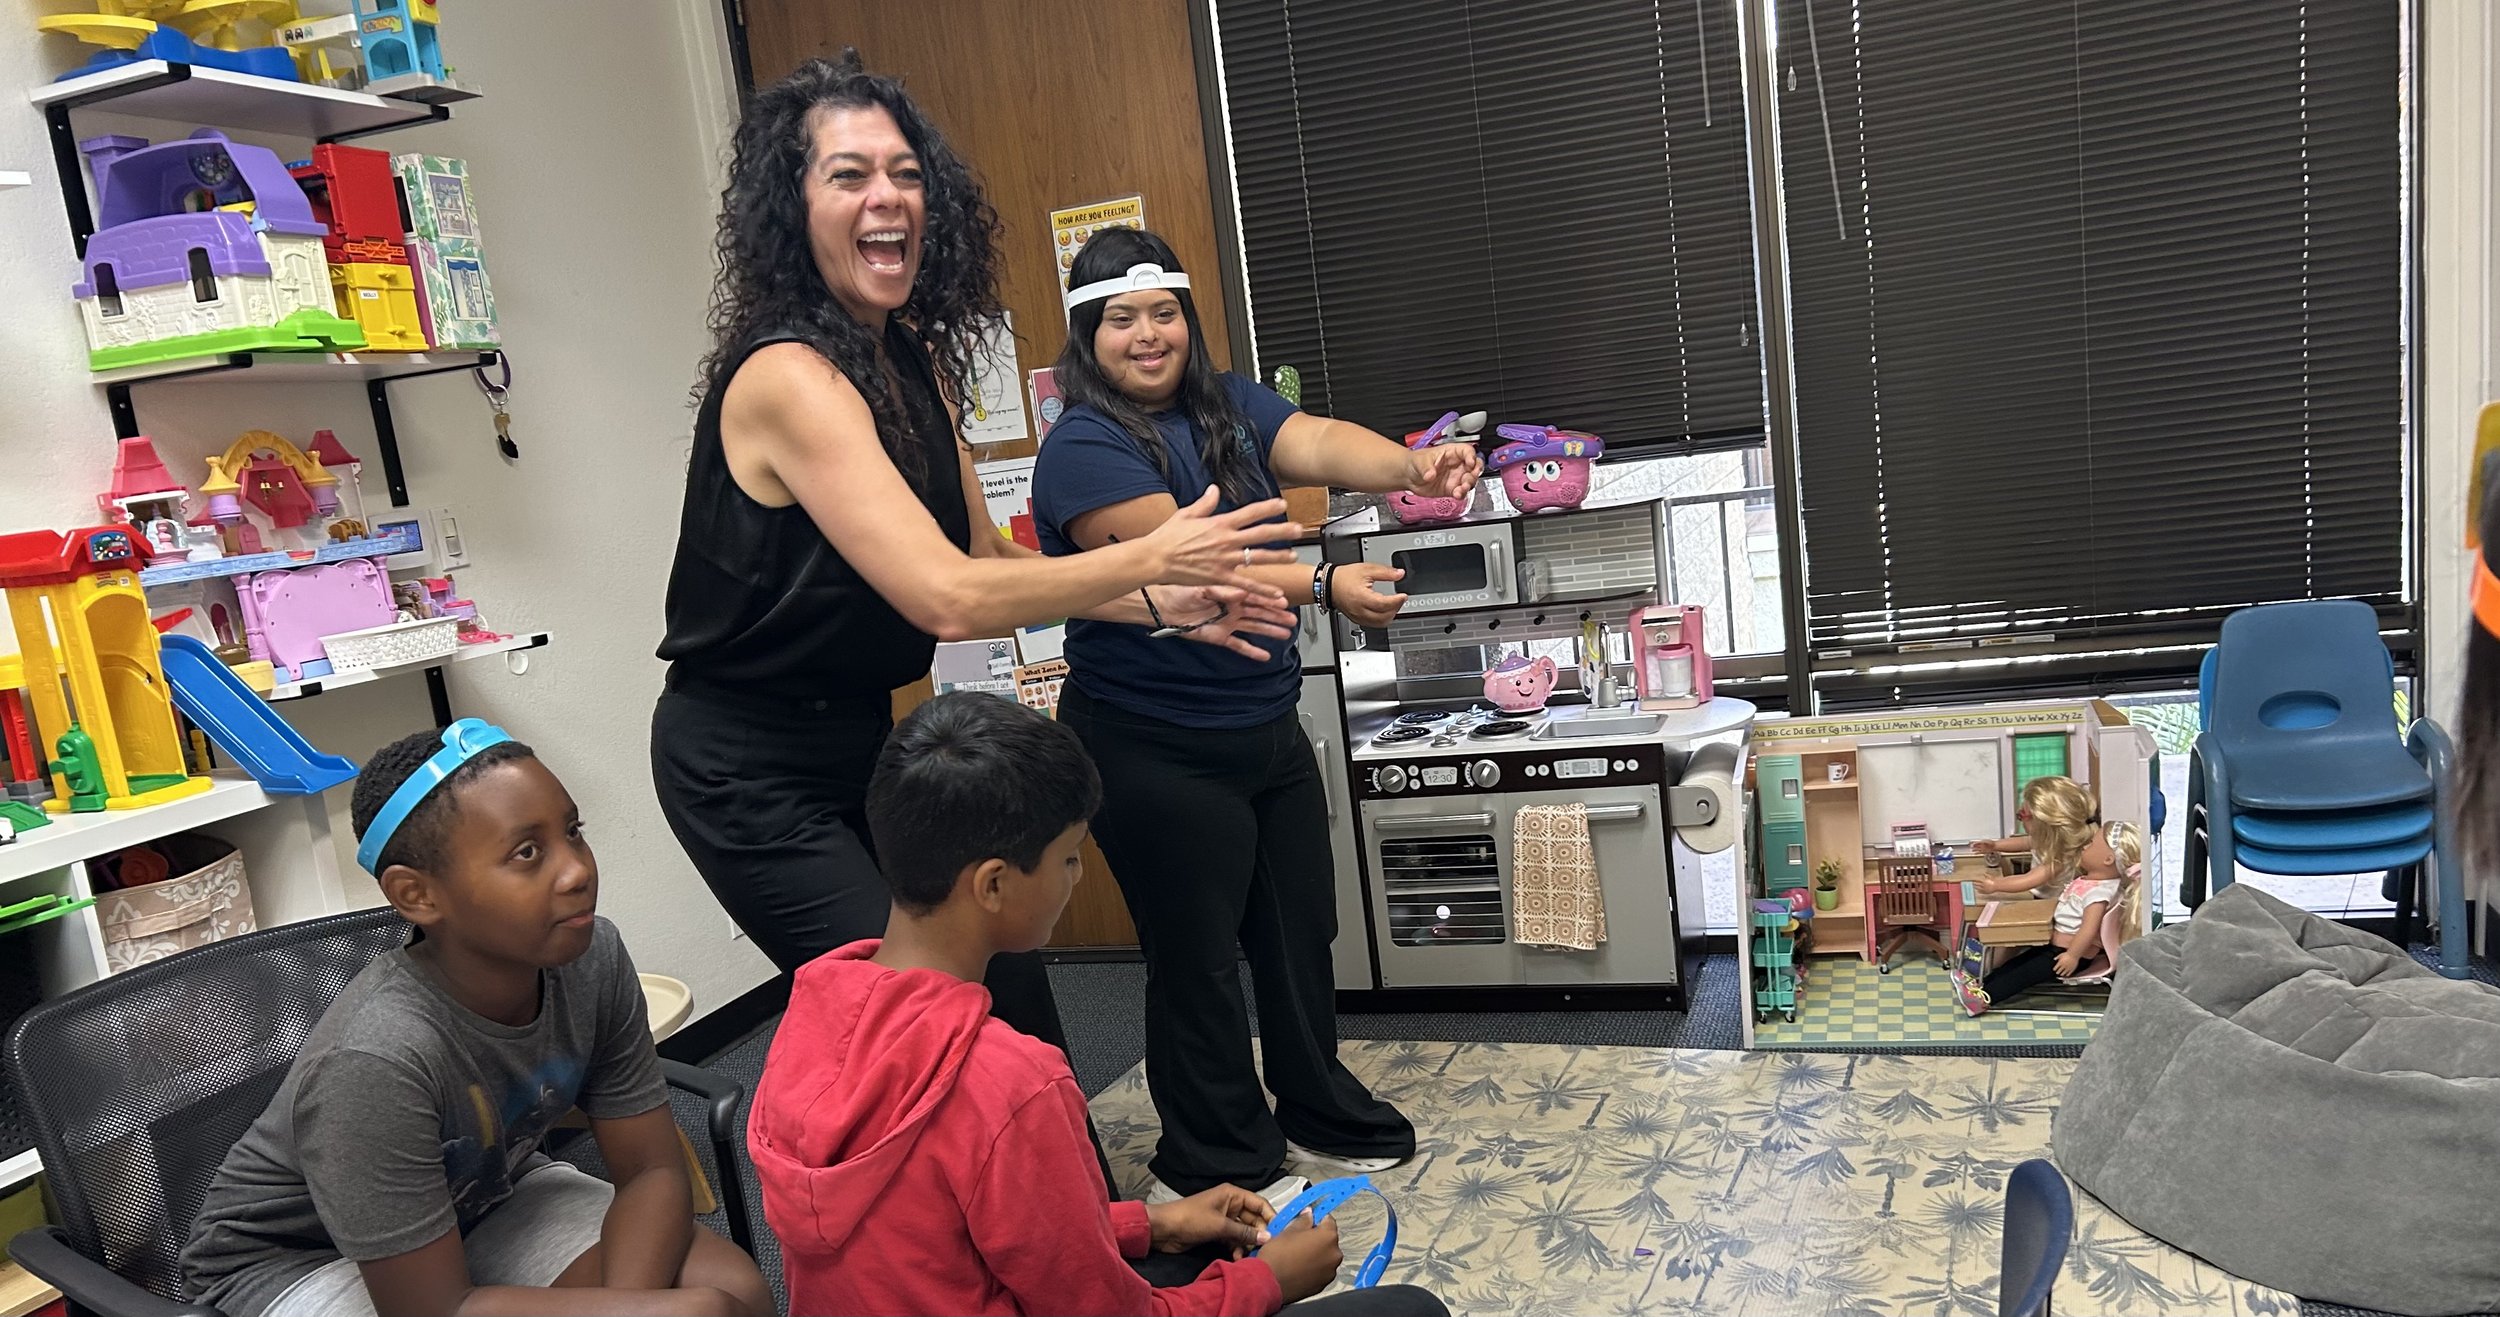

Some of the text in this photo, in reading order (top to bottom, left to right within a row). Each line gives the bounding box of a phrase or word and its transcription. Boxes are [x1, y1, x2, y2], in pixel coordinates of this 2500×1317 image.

[1058, 205, 1134, 225] HOW ARE YOU FEELING?
[986, 477, 1005, 488] level
[1006, 476, 1013, 485] is
[1015, 475, 1028, 484] the
[983, 488, 1015, 499] roblem?
[1024, 668, 1041, 677] What
[1829, 726, 1840, 734] Gg
[1862, 724, 1870, 733] Jj
[1938, 720, 1948, 728] Pp
[1950, 719, 1962, 728] Qq
[2060, 712, 2070, 720] Yy
[1428, 774, 1452, 783] 12:30
